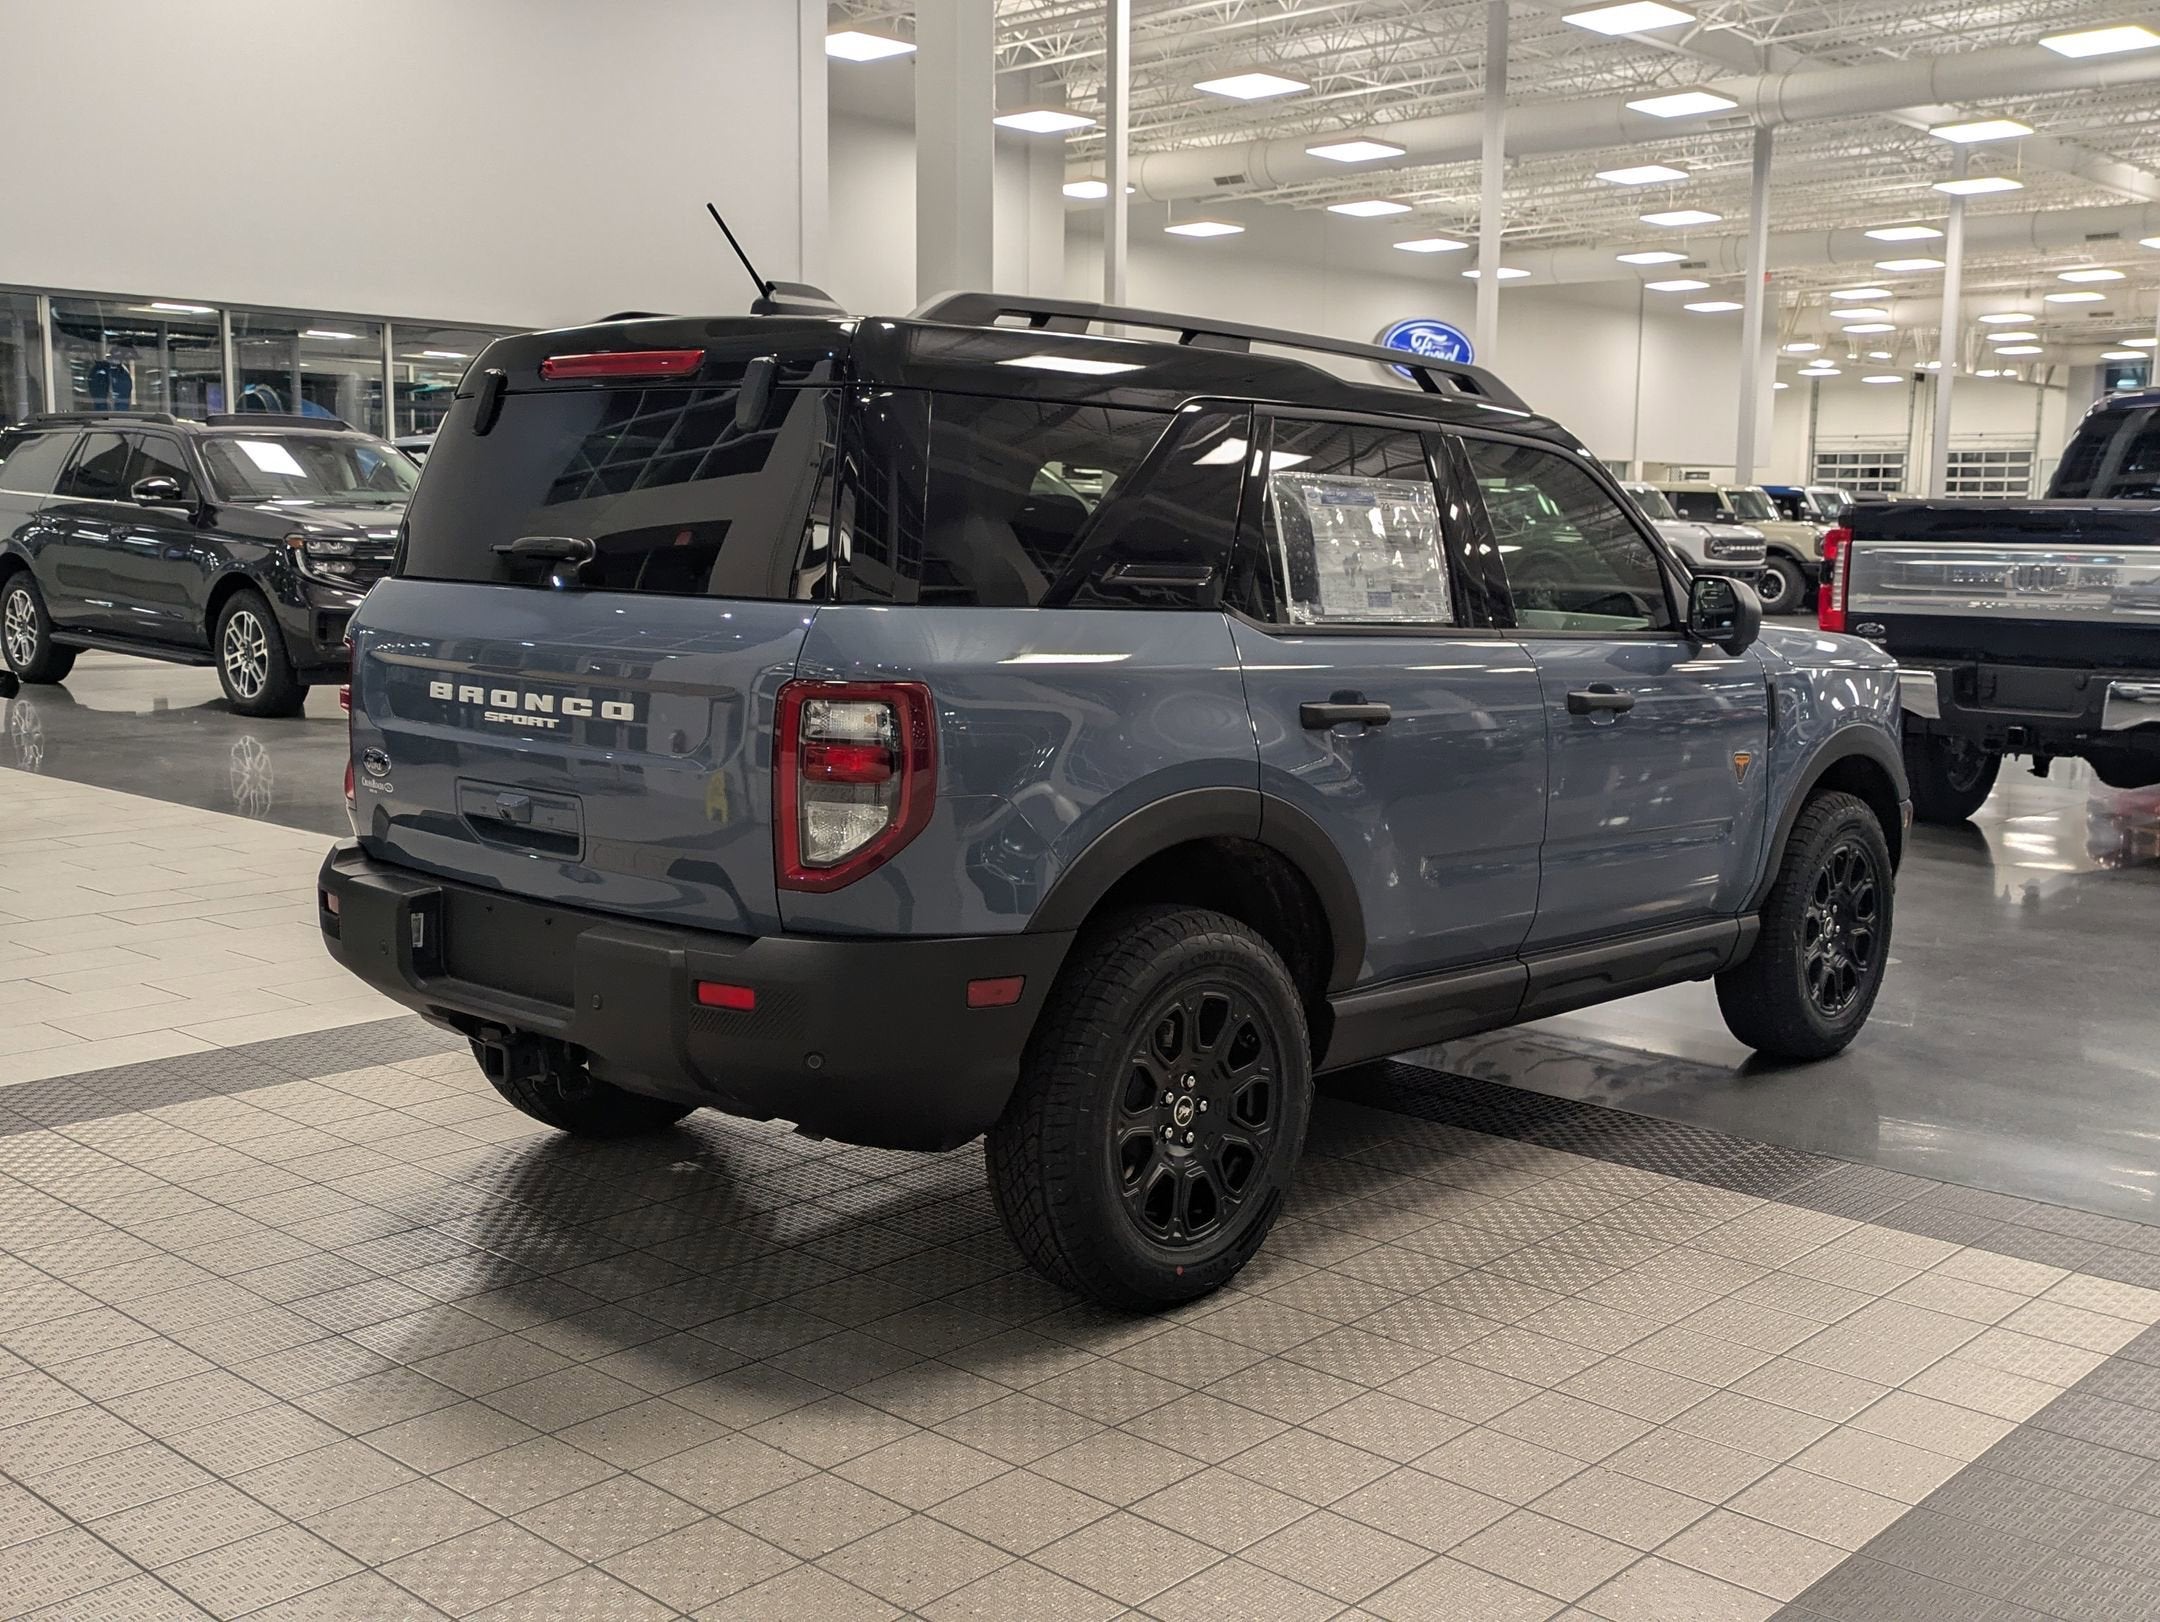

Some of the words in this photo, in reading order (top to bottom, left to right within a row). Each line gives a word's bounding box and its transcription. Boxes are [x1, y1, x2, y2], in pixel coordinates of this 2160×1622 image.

[1408, 328, 1460, 361] Ford
[429, 681, 635, 721] BRONCO
[484, 711, 560, 729] SPORT
